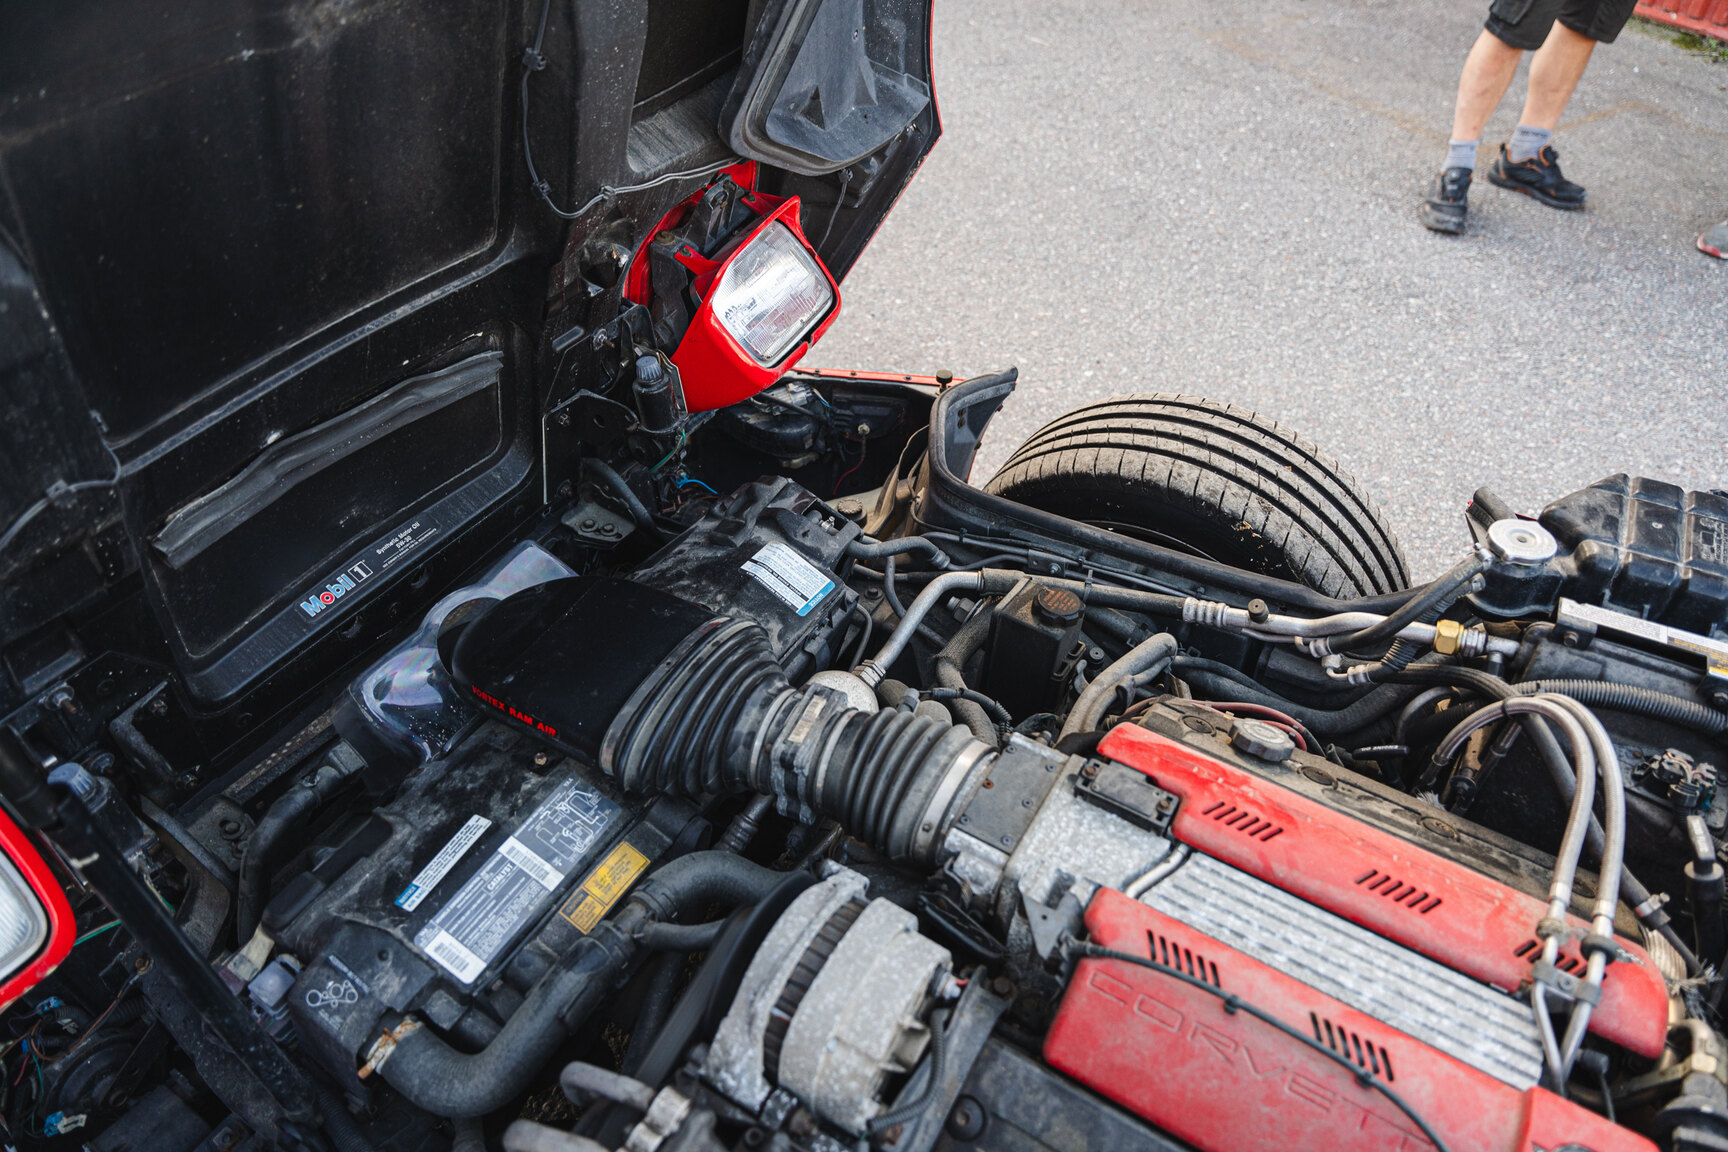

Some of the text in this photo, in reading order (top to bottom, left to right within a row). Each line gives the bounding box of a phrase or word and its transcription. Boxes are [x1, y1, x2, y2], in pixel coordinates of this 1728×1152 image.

[376, 538, 399, 554] Synthetic
[398, 528, 412, 539] Motor
[396, 536, 412, 548] 5W-30
[300, 573, 356, 617] Mobil
[808, 592, 824, 607] NOTICE
[472, 684, 556, 736] VORTEX RAM AIR
[487, 863, 514, 890] CATALYST
[1089, 968, 1434, 1152] CORVETT
